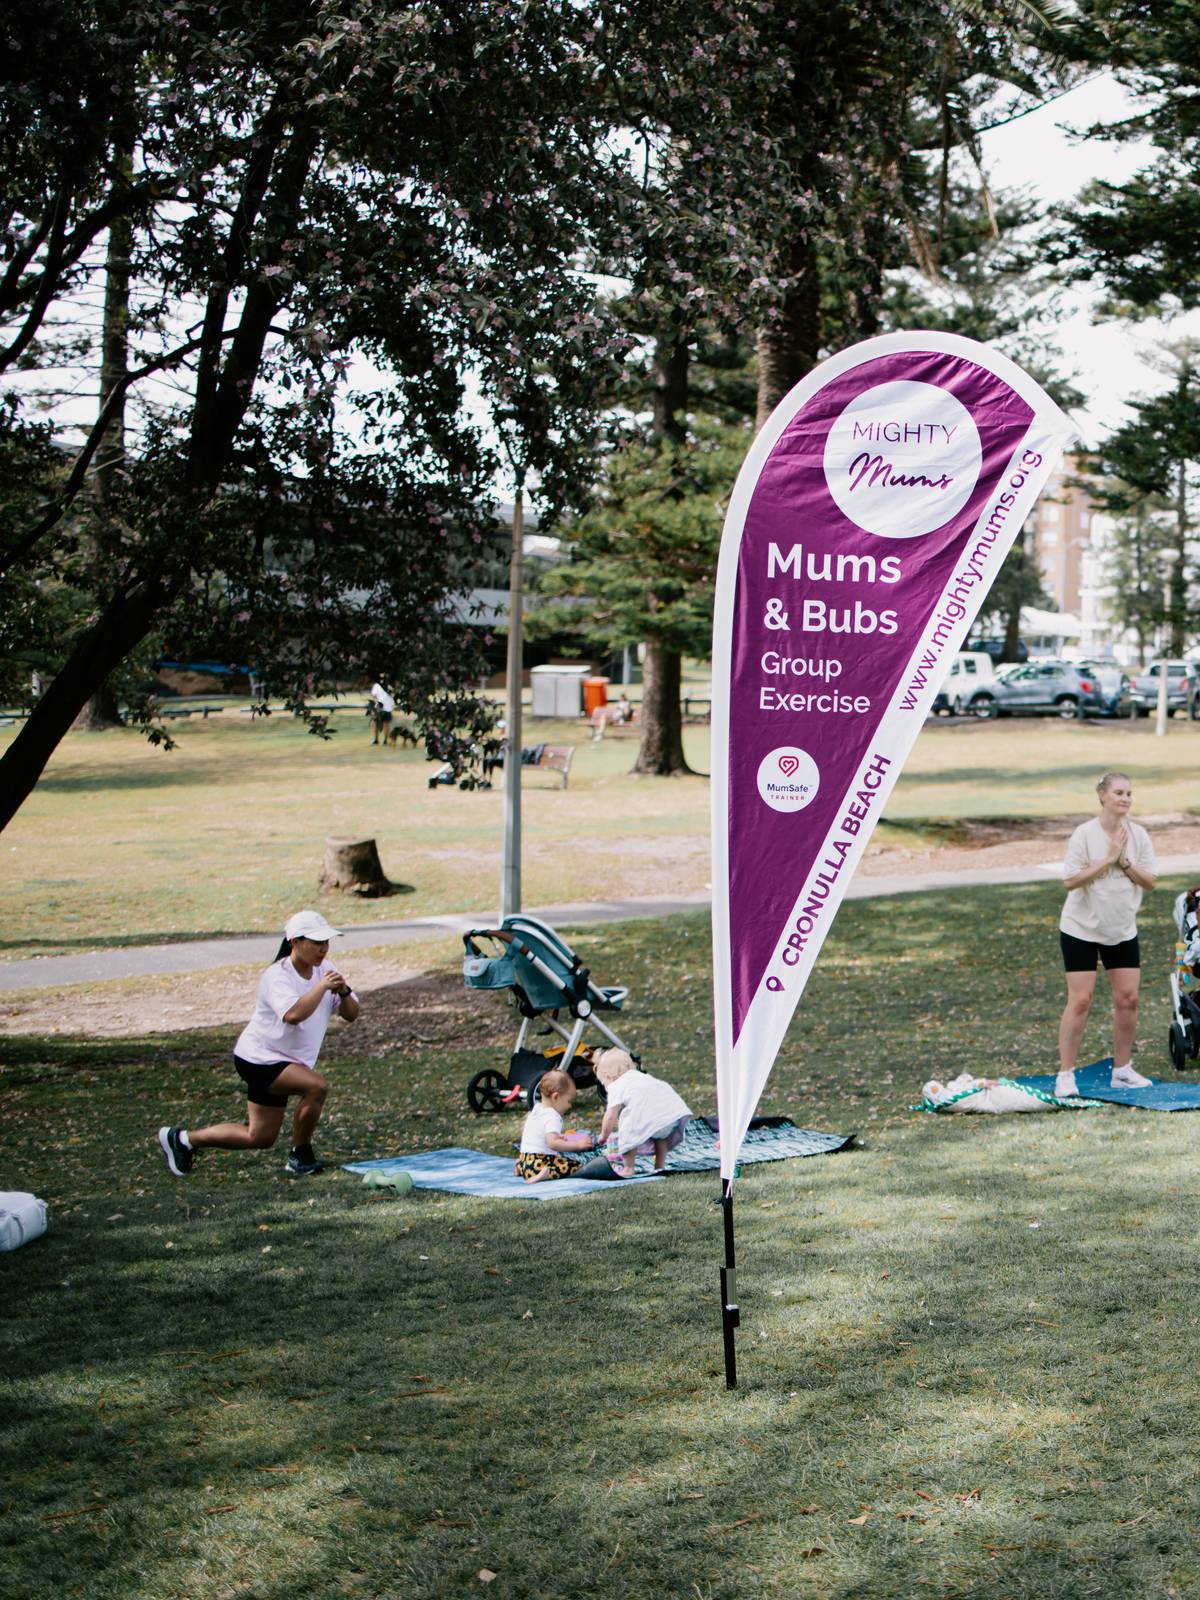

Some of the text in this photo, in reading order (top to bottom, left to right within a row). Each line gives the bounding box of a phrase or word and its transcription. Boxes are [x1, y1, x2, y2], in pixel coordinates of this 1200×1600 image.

[853, 421, 958, 445] MIGHTY
[849, 452, 953, 492] Mums
[767, 542, 902, 584] Mums
[899, 449, 1043, 711] www.mightymums.org
[763, 597, 900, 635] & Bubs
[761, 651, 842, 682] Group
[759, 687, 871, 714] Exercise
[781, 753, 892, 967] CRONULLA BEACH
